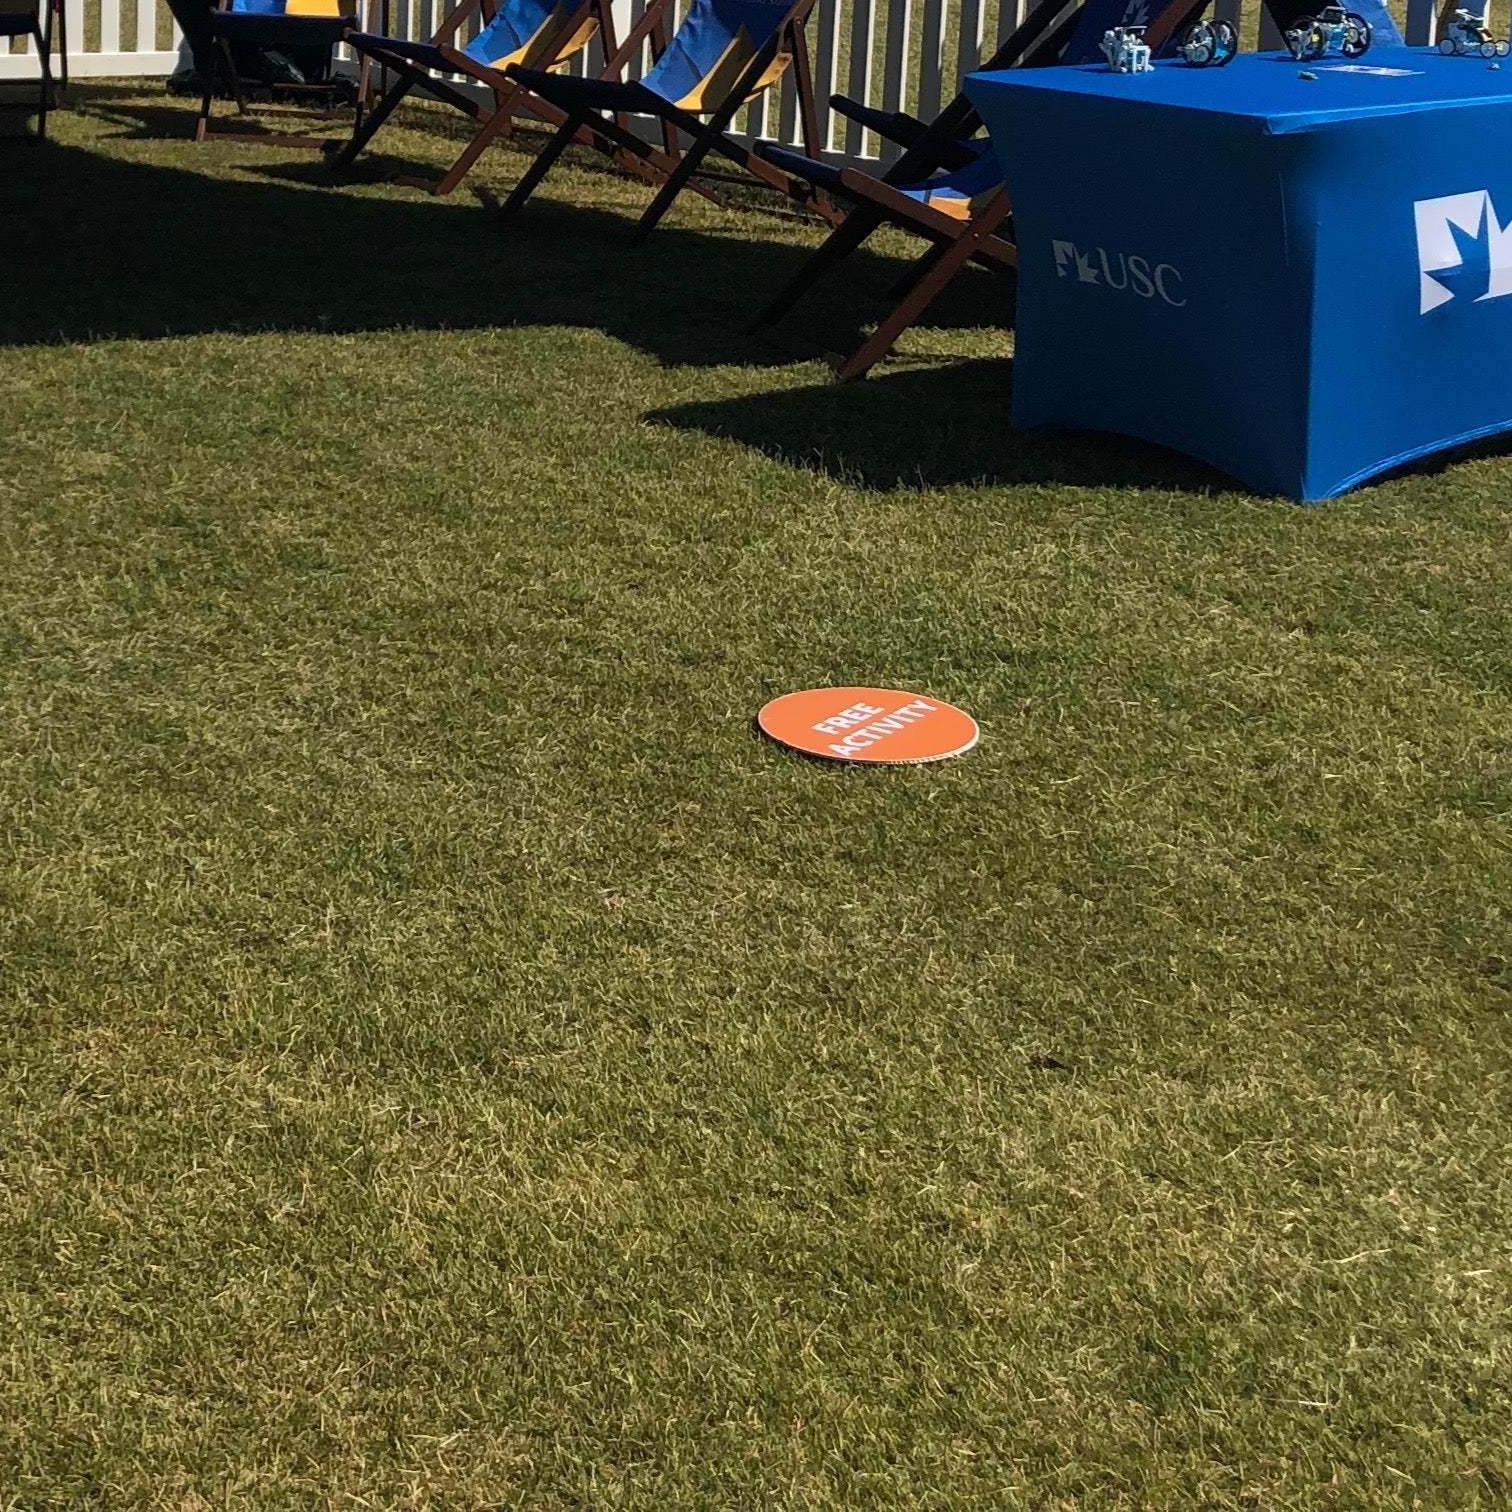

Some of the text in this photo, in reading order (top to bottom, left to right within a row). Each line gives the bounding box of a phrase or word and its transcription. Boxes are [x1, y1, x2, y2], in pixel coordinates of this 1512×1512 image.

[1096, 247, 1187, 307] USC
[810, 702, 885, 735] FREE
[826, 699, 938, 757] ACTIVITY
